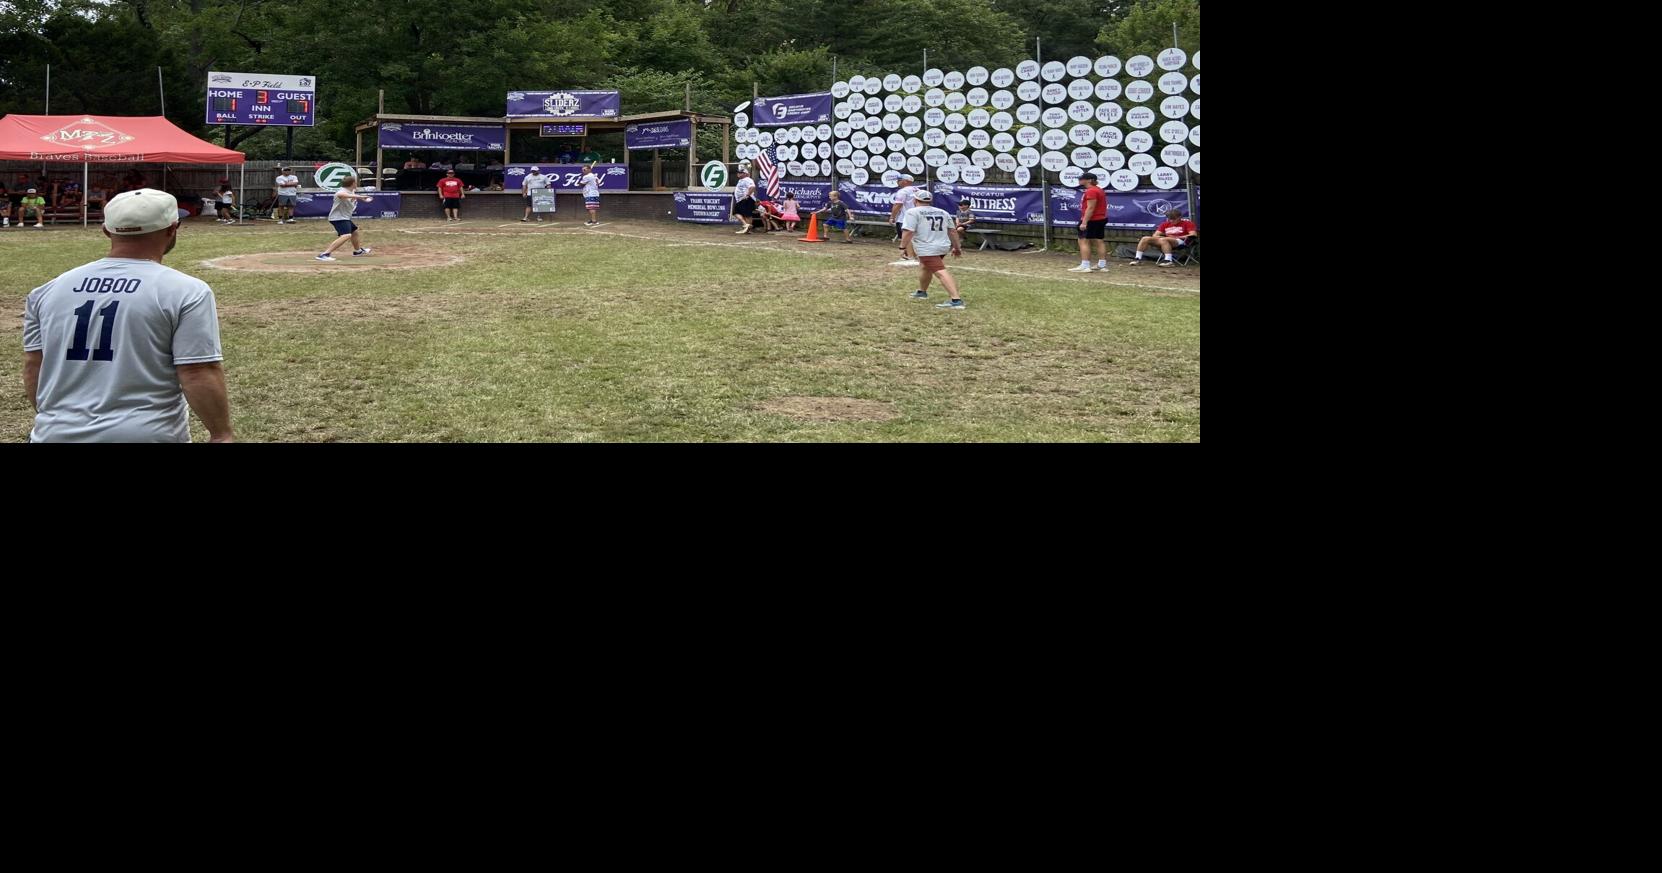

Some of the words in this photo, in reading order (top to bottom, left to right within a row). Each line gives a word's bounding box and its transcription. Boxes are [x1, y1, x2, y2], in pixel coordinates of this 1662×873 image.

[262, 80, 282, 88] Field
[257, 90, 268, 103] 3
[297, 100, 308, 112] 7
[544, 99, 580, 107] SLIDERZ
[413, 129, 474, 140] Brinkoetter
[30, 152, 79, 160] Braves
[73, 278, 142, 293] JOBOO
[66, 300, 120, 361] 11
